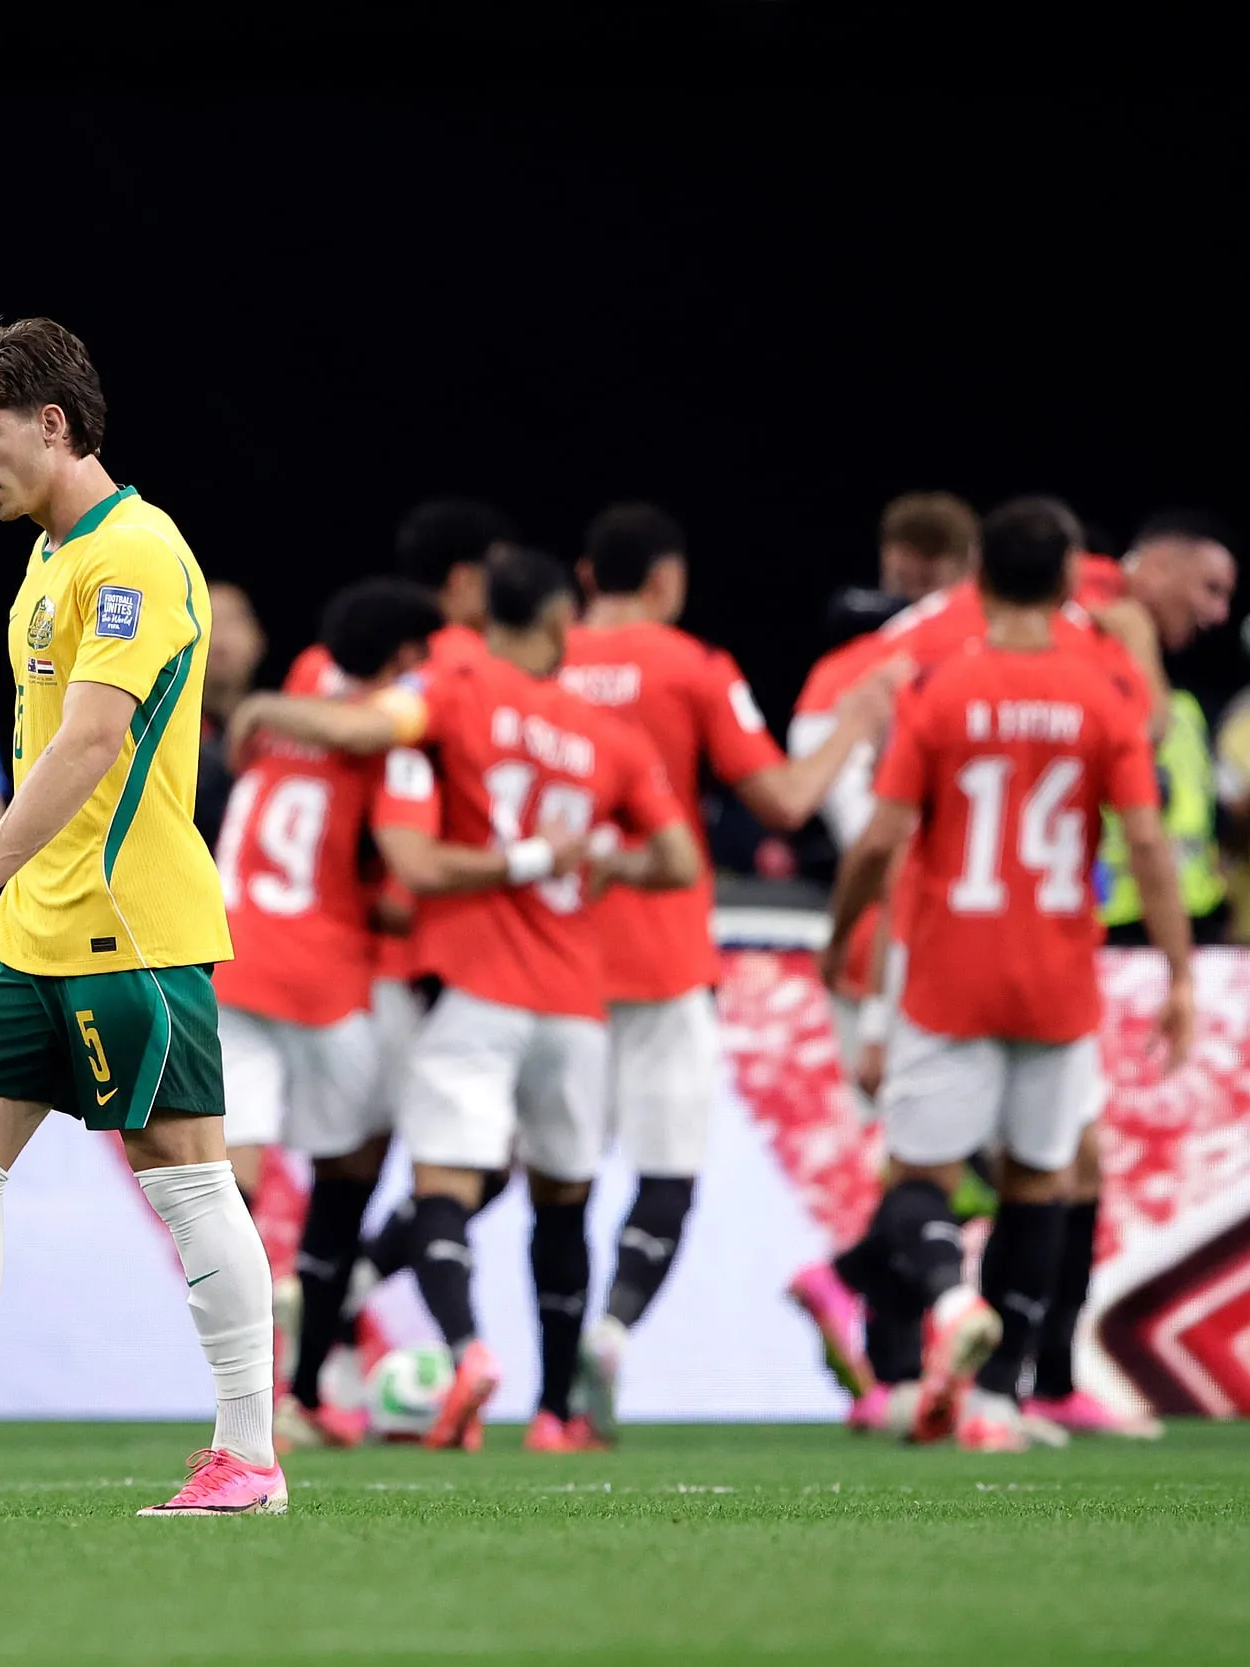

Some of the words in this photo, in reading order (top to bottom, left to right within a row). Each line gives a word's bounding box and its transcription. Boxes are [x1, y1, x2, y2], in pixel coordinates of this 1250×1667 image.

[104, 594, 133, 605] FOOTBALL
[104, 602, 132, 616] UNITES
[216, 769, 331, 918] 19
[948, 755, 1087, 916] 14
[75, 1009, 111, 1083] 5
